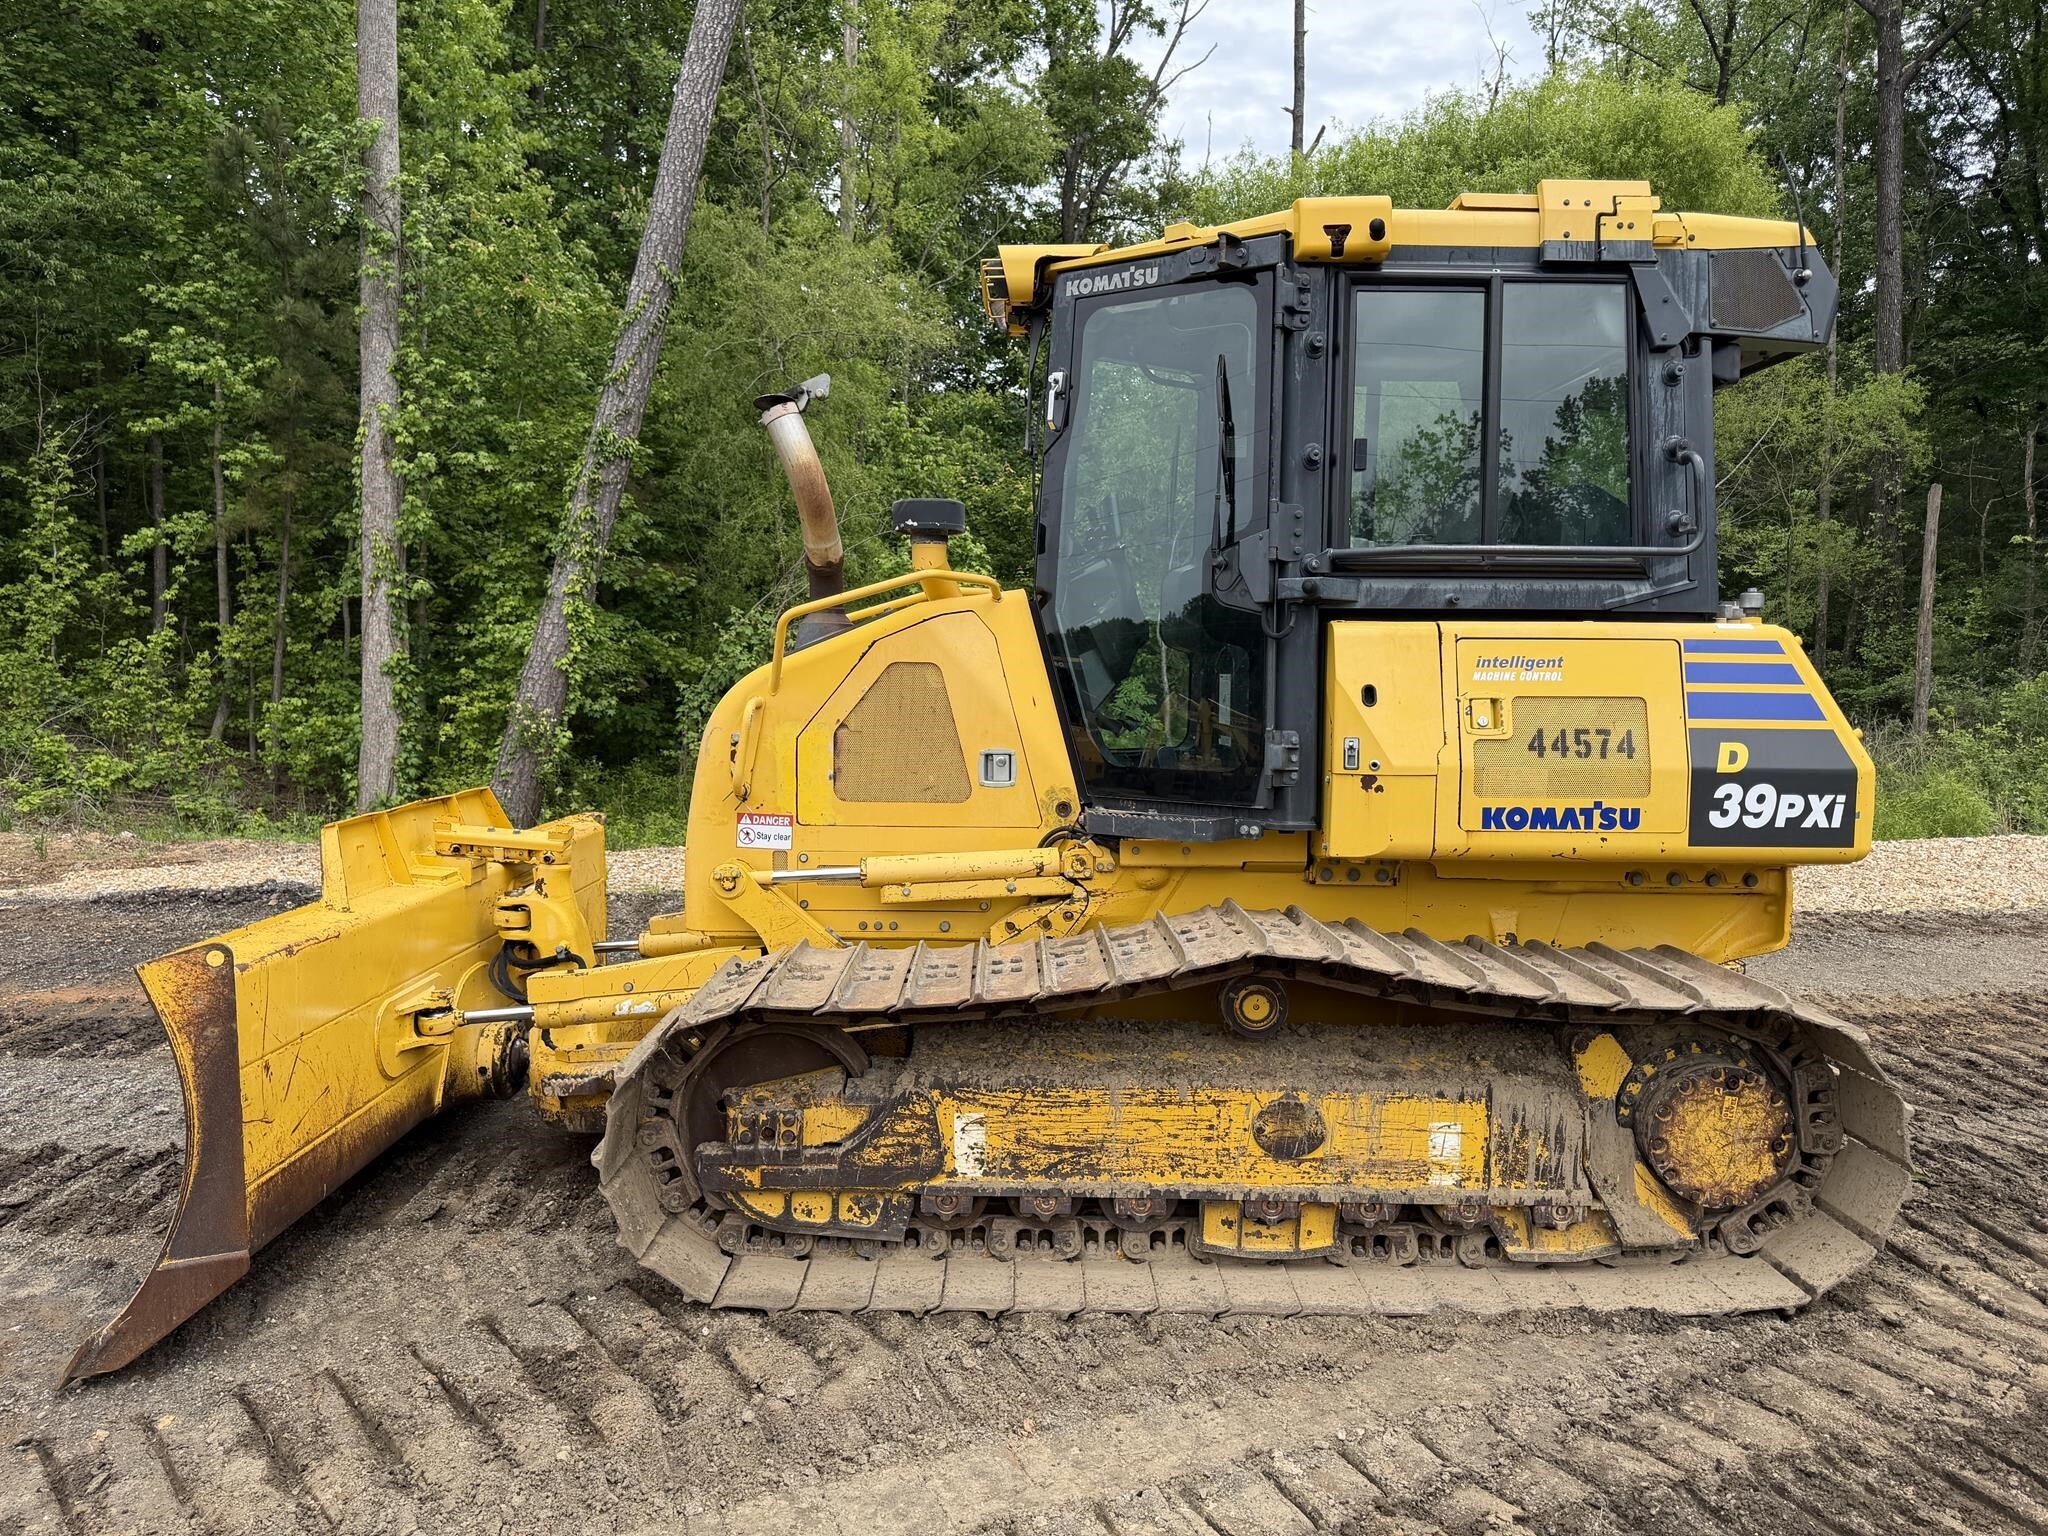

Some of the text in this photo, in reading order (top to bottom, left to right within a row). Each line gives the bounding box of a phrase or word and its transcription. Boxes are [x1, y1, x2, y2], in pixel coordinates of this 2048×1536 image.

[1066, 266, 1158, 296] KOMATSU
[1476, 656, 1564, 671] intelligent
[1472, 671, 1563, 681] MACHINE CONTROL
[1527, 728, 1636, 759] 44574
[1716, 742, 1749, 773] D
[752, 815, 791, 826] DANGER
[1482, 801, 1641, 831] KOMATSU
[756, 831, 791, 842] Stay clear
